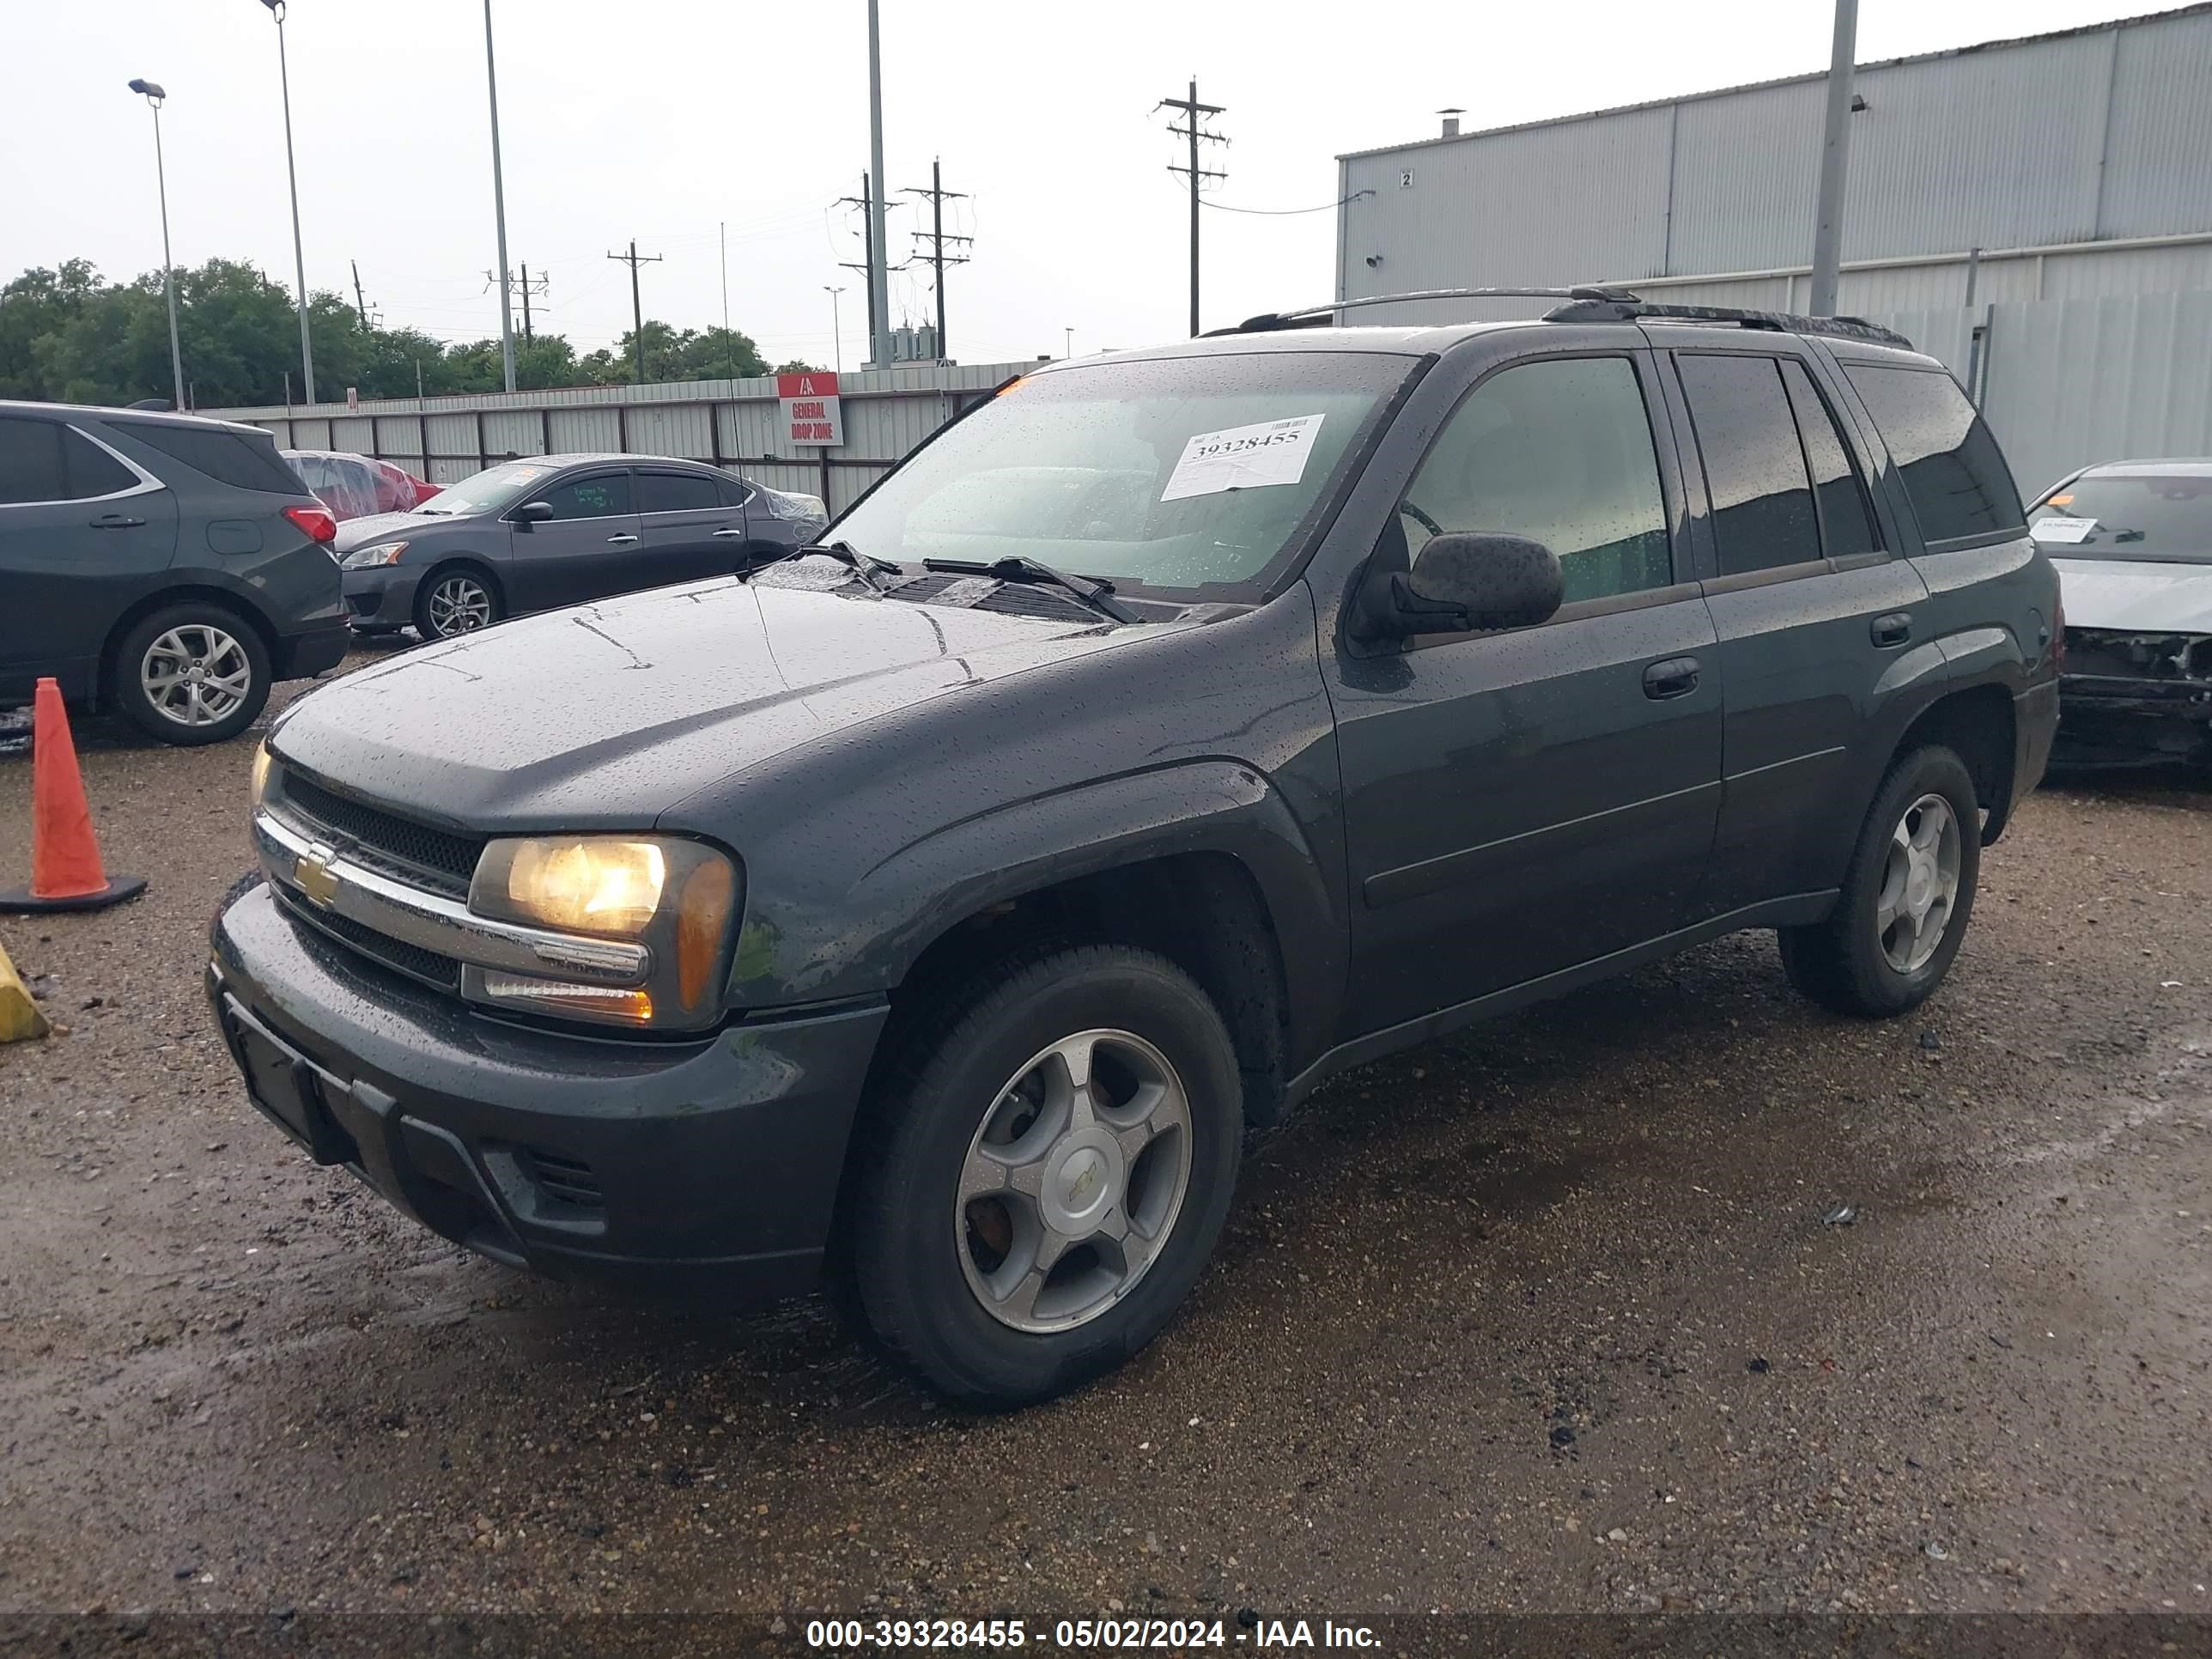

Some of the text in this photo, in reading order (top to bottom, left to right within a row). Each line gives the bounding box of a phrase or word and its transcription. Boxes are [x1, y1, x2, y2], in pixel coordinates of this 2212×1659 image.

[1403, 174, 1410, 185] 2
[792, 402, 826, 419] GENERAL
[792, 422, 833, 440] DROP ZONE
[1192, 429, 1302, 459] 39328455
